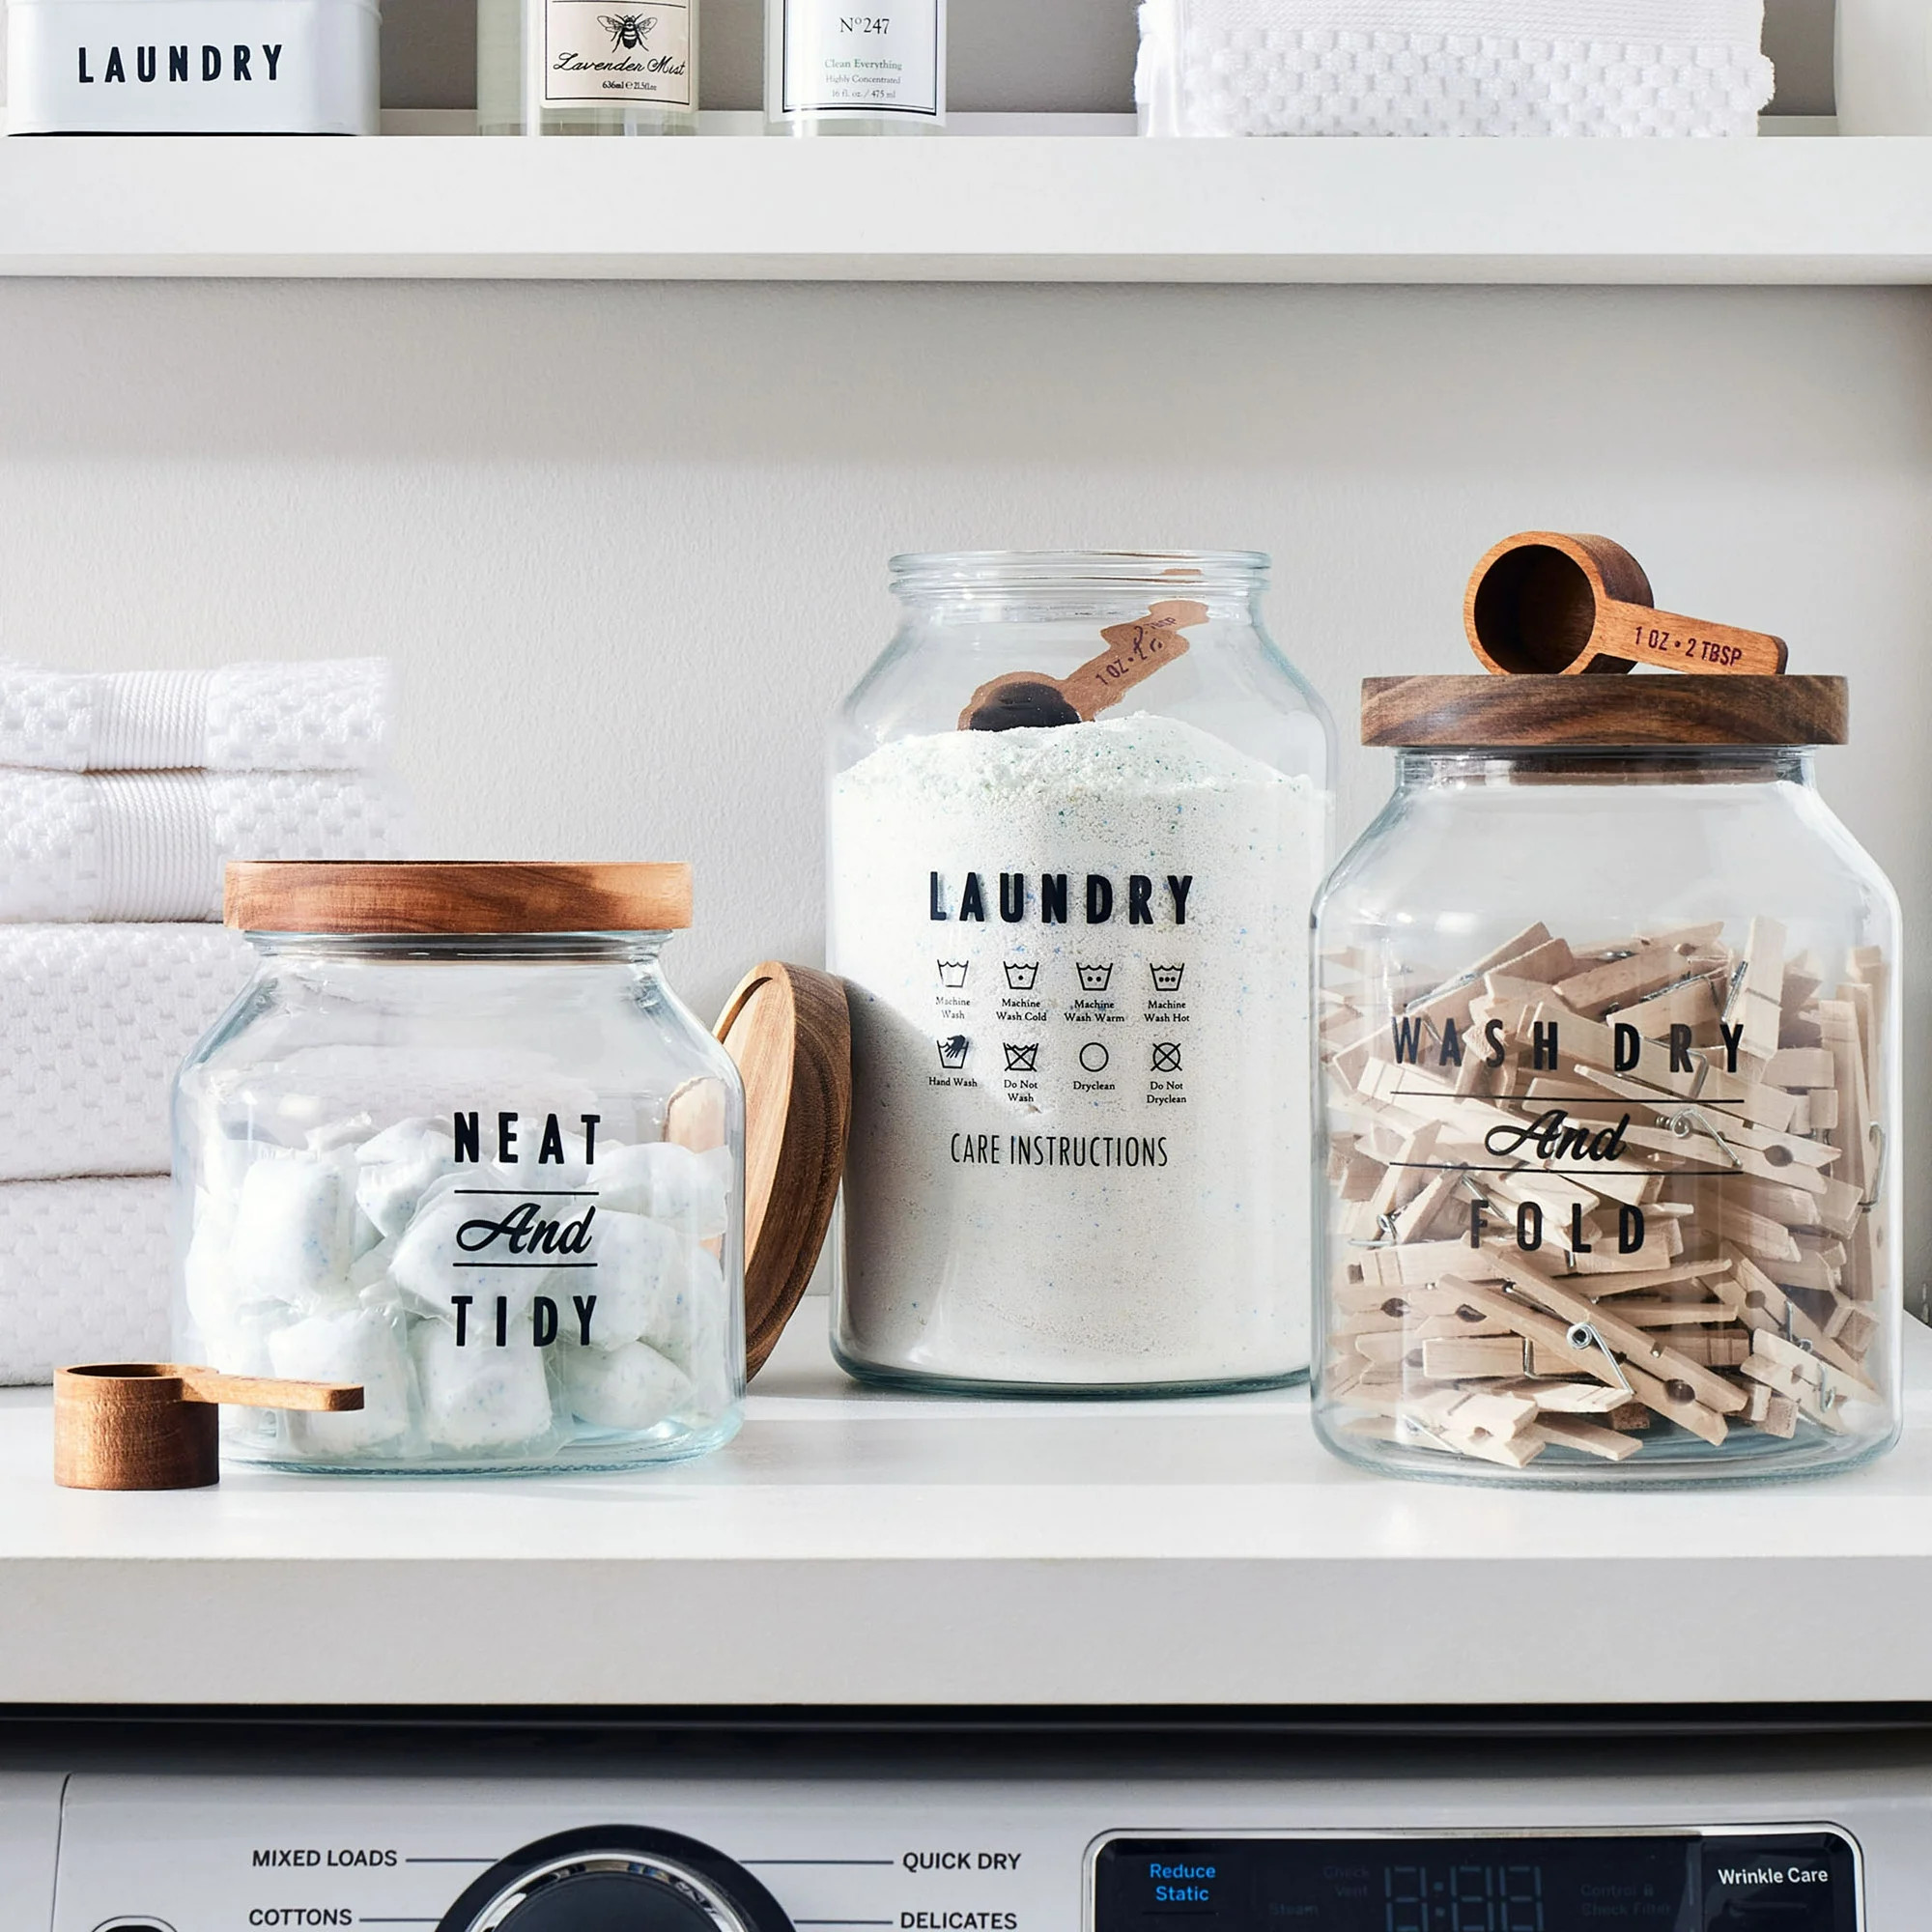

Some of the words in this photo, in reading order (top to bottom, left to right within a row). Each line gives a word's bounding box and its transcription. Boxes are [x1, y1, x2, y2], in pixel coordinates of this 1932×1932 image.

[78, 44, 283, 84] LAUNDRY
[553, 52, 644, 71] Lavender
[646, 55, 687, 75] Mist
[824, 58, 851, 68] Clean
[854, 58, 902, 71] Everything
[602, 80, 624, 90] 636ml
[825, 74, 850, 85] Highly
[851, 74, 901, 84] Concentrated
[870, 89, 885, 99] 475
[886, 90, 896, 99] ml
[1634, 626, 1642, 645] 1
[1648, 629, 1670, 651] OZ
[1685, 638, 1697, 658] 2
[1701, 640, 1743, 667] TBSP
[1106, 659, 1129, 678] OZ
[929, 871, 1193, 924] LAUNDRY
[935, 996, 971, 1006] Machine
[1002, 998, 1041, 1008] Machine
[1074, 1000, 1115, 1009] Machine
[1148, 1000, 1186, 1009] Machine
[941, 1009, 965, 1019] Wash
[996, 1011, 1022, 1021] Wash
[1024, 1011, 1047, 1021] Cold
[1064, 1012, 1092, 1022] Wash
[1094, 1012, 1125, 1022] Warm
[1144, 1012, 1171, 1022] Wash
[1173, 1012, 1190, 1022] Hot
[1391, 1015, 1558, 1071] WASH
[1614, 1023, 1745, 1073] DRY
[928, 1076, 952, 1087] Hand
[952, 1077, 978, 1088] Wash
[1004, 1079, 1017, 1089] Do
[1019, 1079, 1038, 1090] Not
[1072, 1080, 1116, 1093] Dryclean
[1150, 1080, 1163, 1091] Do
[1166, 1080, 1183, 1091] Not
[1008, 1093, 1035, 1102] Wash
[1147, 1094, 1187, 1106] Dryclean
[454, 1111, 601, 1165] NEAT
[1484, 1109, 1631, 1162] And
[951, 1132, 1001, 1165] CARE
[1010, 1135, 1169, 1167] INSTRUCTIONS
[456, 1202, 596, 1255] And
[1470, 1199, 1644, 1255] FOLD
[451, 1294, 598, 1347] TIDY
[252, 1849, 322, 1866] MIXED
[327, 1849, 398, 1867] LOADS
[902, 1851, 972, 1873] QUICK
[978, 1852, 1022, 1870] DRY
[1150, 1862, 1217, 1879] Reduce
[1718, 1867, 1784, 1885] Wrinkle
[1787, 1866, 1829, 1883] Care
[1155, 1886, 1209, 1901] Static
[248, 1908, 353, 1926] COTTONS
[900, 1912, 1018, 1930] DELICATES
